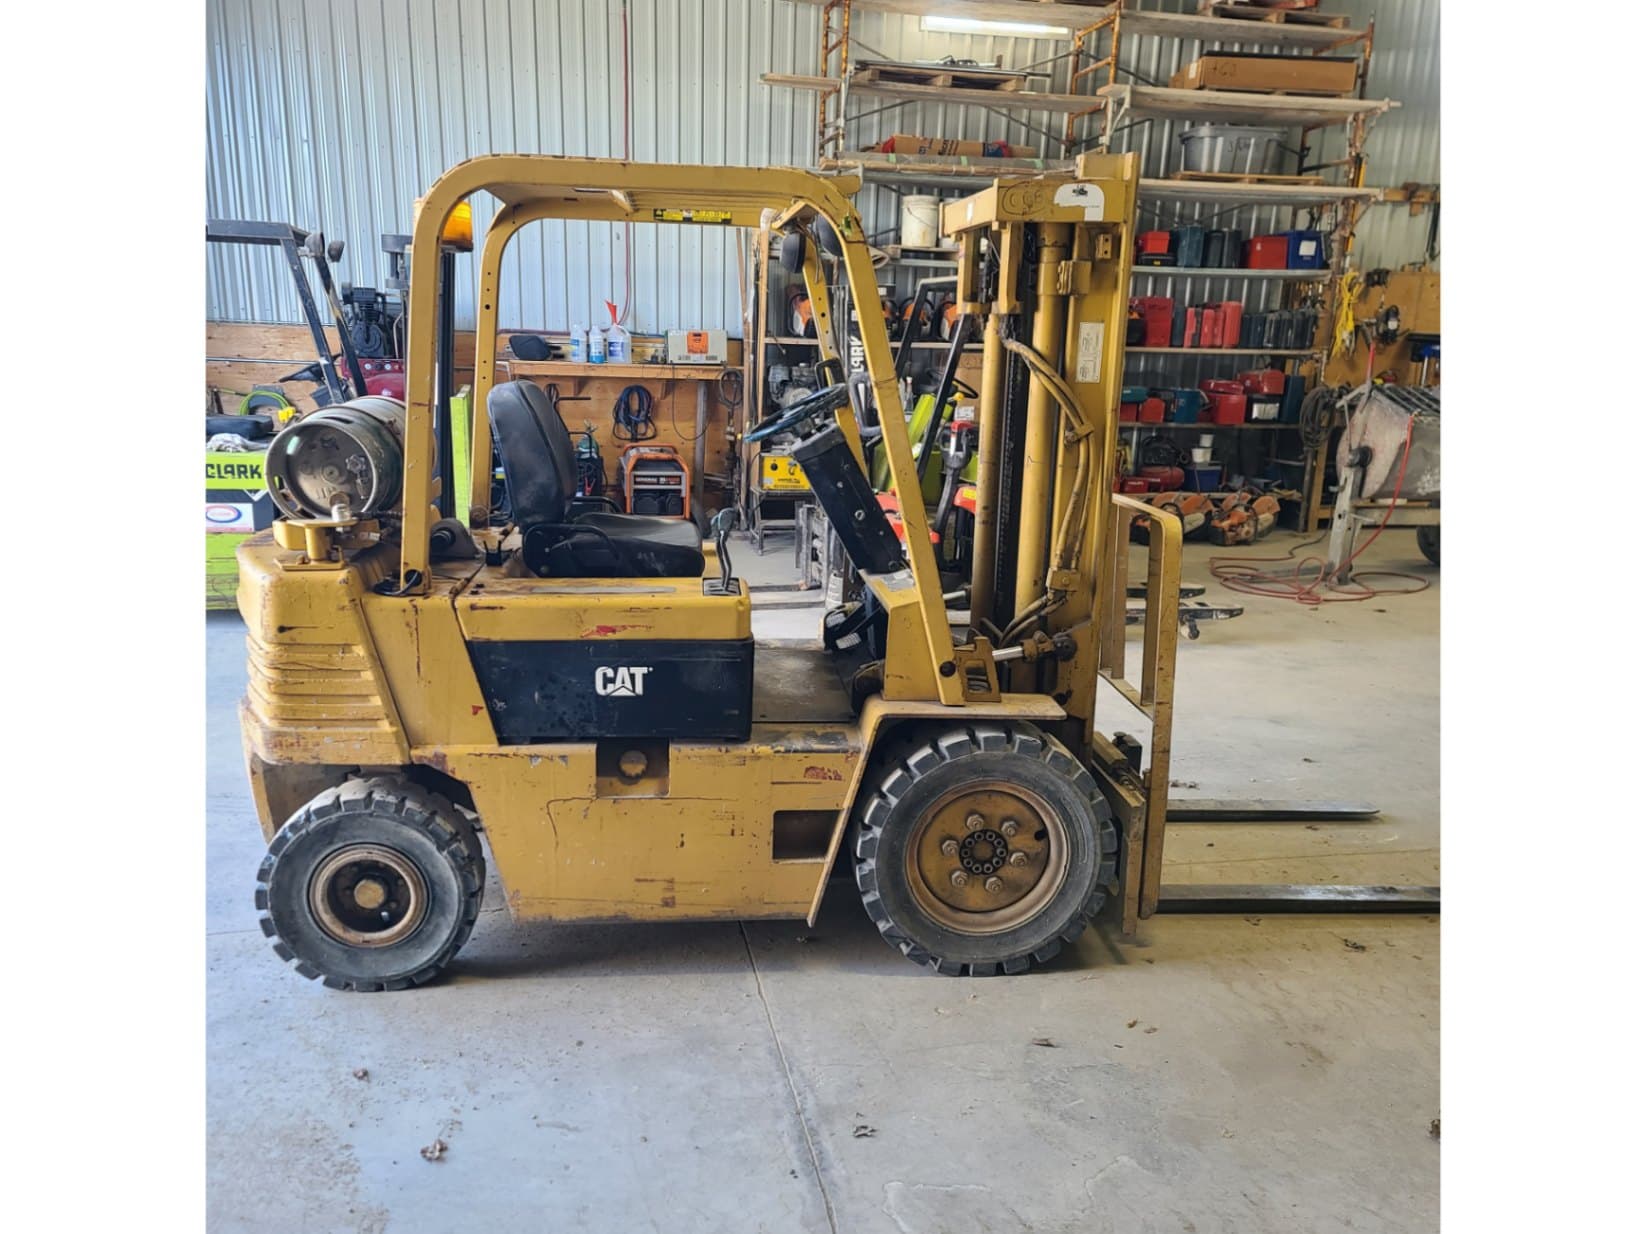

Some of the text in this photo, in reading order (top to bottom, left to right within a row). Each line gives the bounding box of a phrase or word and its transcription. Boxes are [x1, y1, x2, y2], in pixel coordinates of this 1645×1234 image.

[850, 335, 865, 373] LARK
[205, 463, 262, 479] CLARK
[595, 666, 648, 696] CAT
